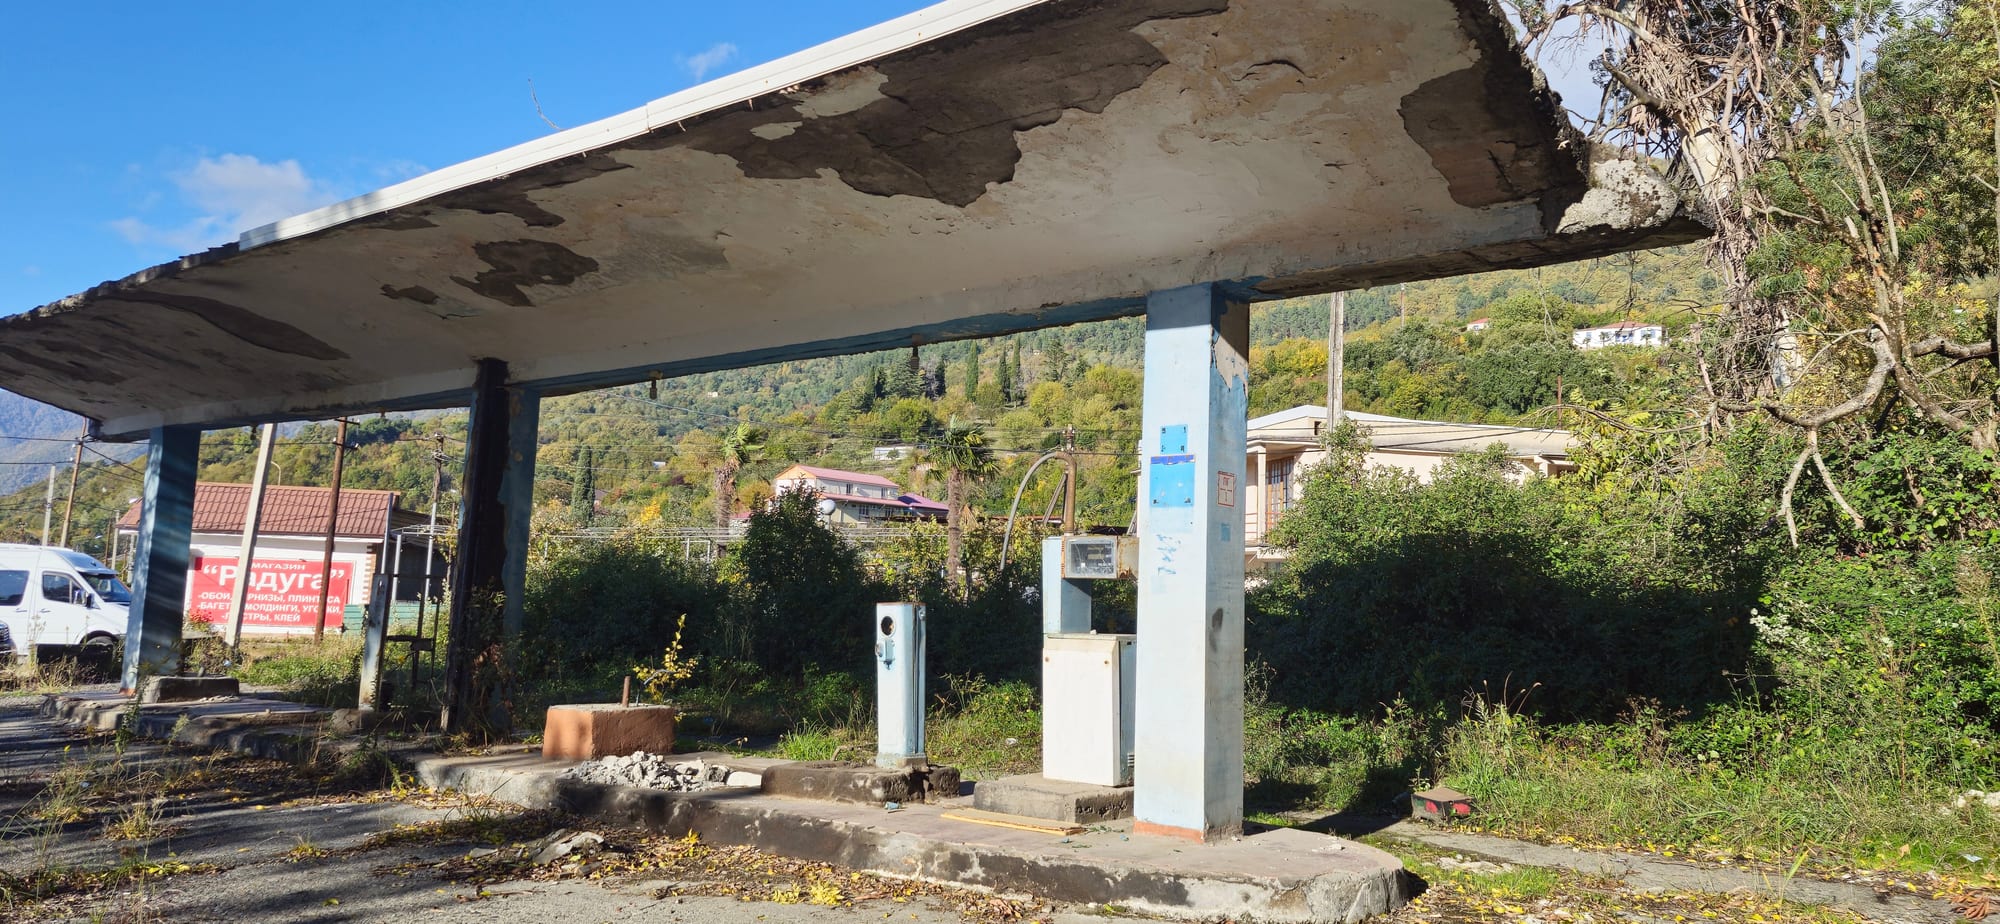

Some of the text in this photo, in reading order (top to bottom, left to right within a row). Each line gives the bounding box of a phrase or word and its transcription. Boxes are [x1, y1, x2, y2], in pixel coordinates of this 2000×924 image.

[248, 593, 285, 603] РНИЗЫ,
[288, 594, 340, 604] ПЛИНТСА
[302, 605, 341, 614] УГОКИ,
[274, 613, 301, 622] КЛЕЙ
